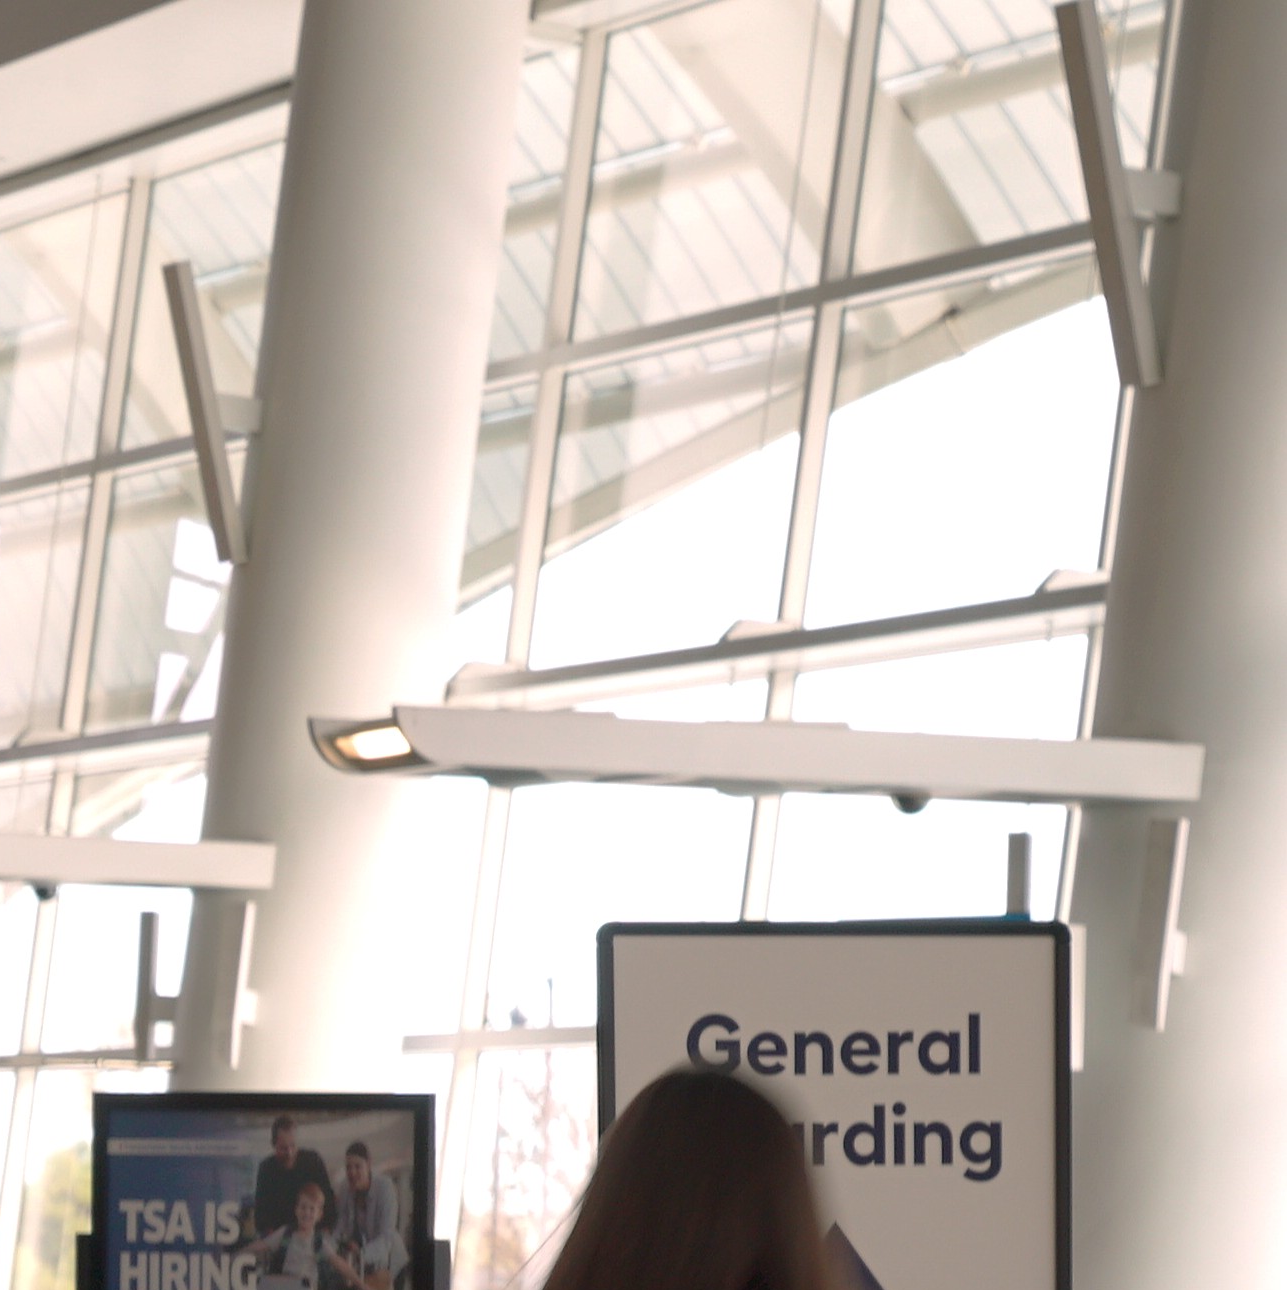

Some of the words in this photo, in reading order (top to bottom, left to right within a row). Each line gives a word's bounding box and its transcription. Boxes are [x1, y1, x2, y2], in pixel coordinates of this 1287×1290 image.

[685, 1012, 982, 1076] General
[792, 1101, 1003, 1183] rding
[119, 1199, 196, 1245] TSA
[203, 1200, 241, 1246] IS
